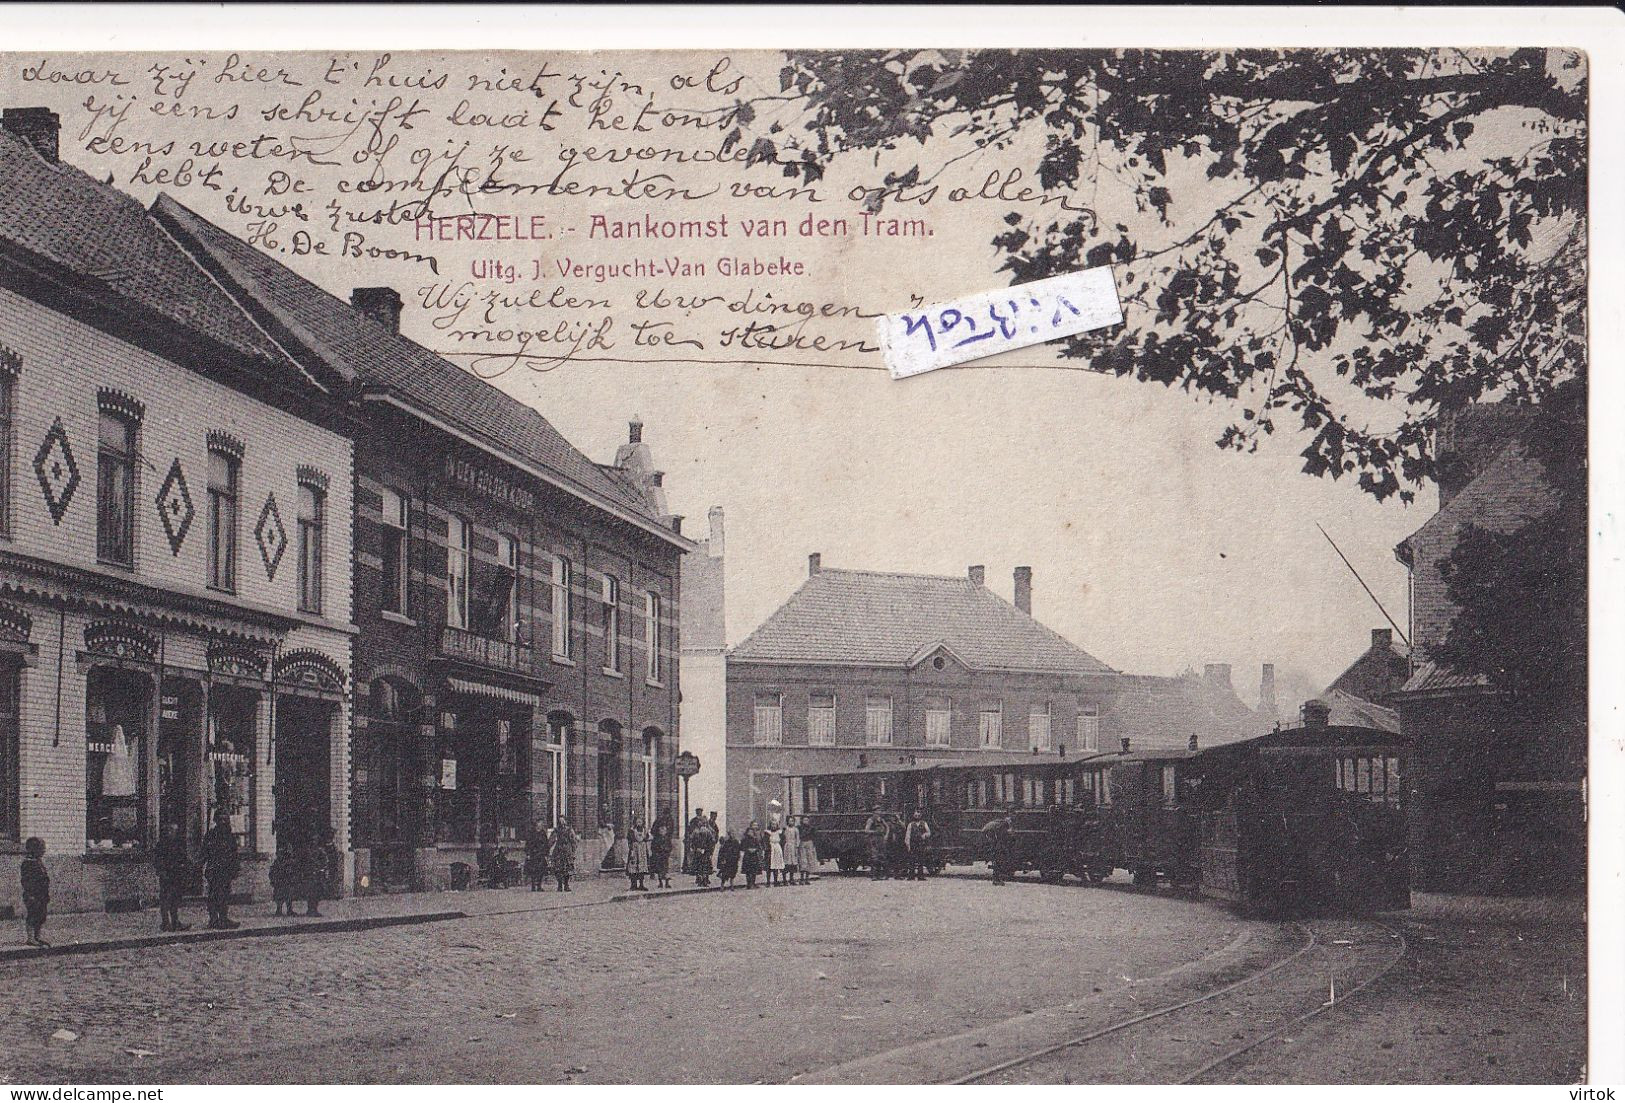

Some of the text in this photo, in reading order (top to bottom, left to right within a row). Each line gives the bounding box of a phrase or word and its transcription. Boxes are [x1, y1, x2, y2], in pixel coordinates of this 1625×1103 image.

[23, 59, 130, 85] daar
[215, 53, 303, 88] hier
[469, 63, 561, 97] niet
[671, 57, 746, 95] als
[150, 101, 240, 121] eens
[447, 98, 563, 131] laat
[189, 131, 341, 166] weten
[353, 134, 400, 180] of
[264, 170, 315, 196] De
[731, 182, 822, 203] van
[728, 288, 886, 324] dingen
[88, 742, 115, 753] MERCE
